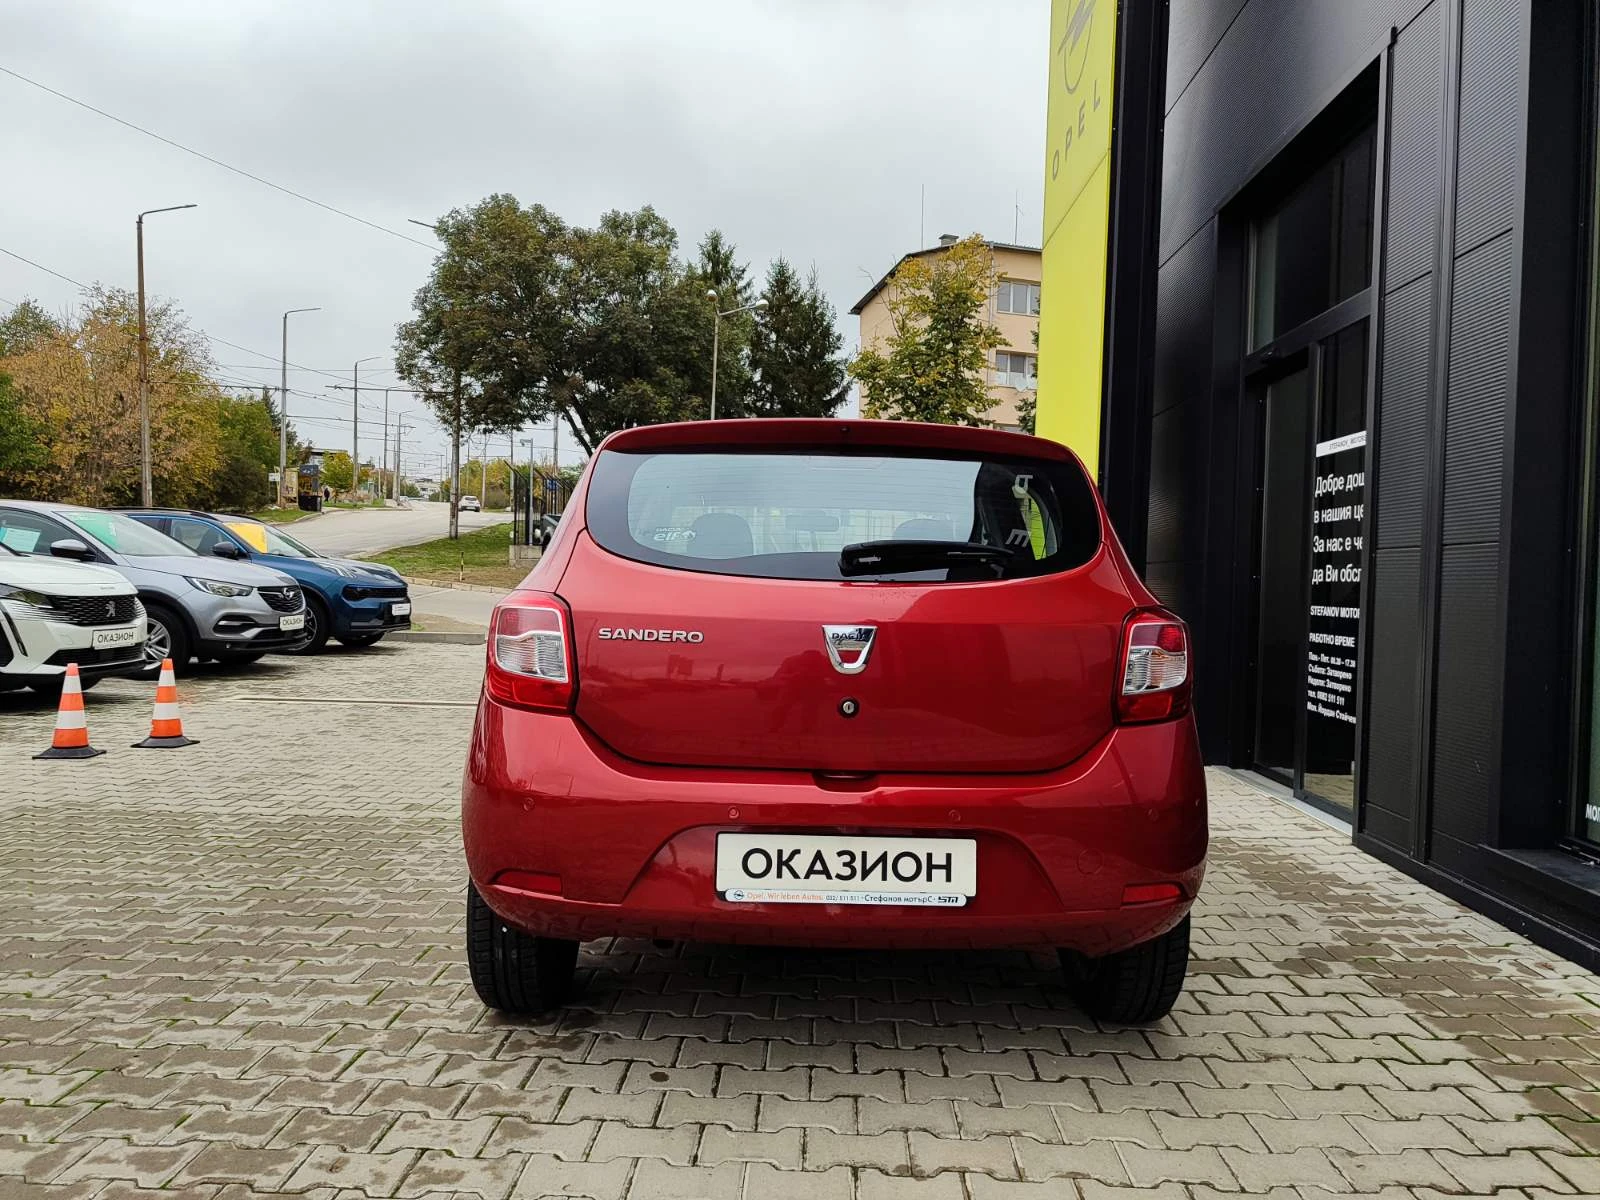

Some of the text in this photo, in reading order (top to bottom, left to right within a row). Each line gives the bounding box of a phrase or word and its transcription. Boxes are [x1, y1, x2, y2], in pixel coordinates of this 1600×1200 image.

[1052, 79, 1101, 181] OPEL
[1315, 473, 1344, 498] Добре
[1313, 510, 1320, 523] в
[1321, 505, 1352, 522] нашия
[1313, 535, 1325, 552] За
[1326, 537, 1343, 552] нас
[1344, 537, 1352, 551] е
[1311, 568, 1324, 585] да
[1325, 564, 1339, 582] Ви
[1310, 605, 1340, 617] STEFANOV
[97, 631, 135, 644] ОКАЗИОН
[597, 627, 705, 644] SANDERO
[831, 631, 867, 642] DACIA
[1309, 632, 1356, 648] РАБОТНО ВРЕМЕ
[740, 847, 953, 884] ОКАЗИОН
